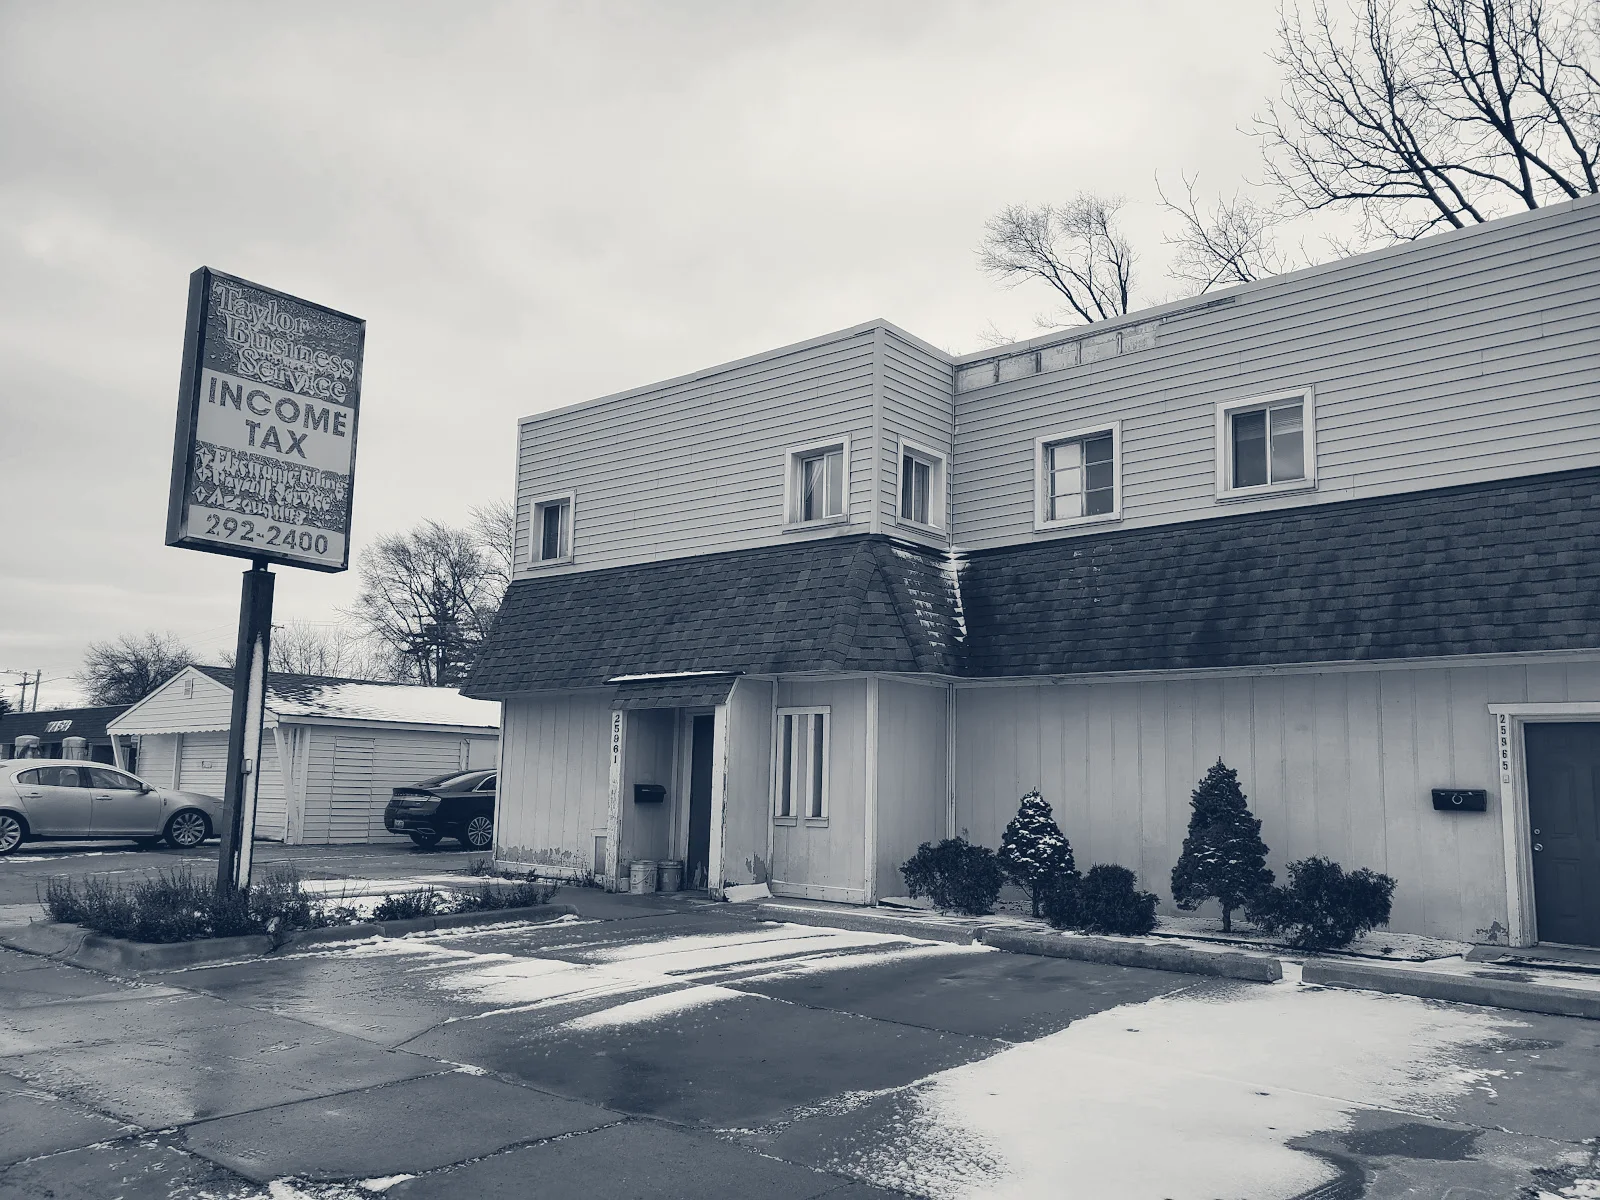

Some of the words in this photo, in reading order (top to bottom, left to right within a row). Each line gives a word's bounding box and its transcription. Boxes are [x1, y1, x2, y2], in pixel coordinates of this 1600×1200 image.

[213, 282, 311, 337] Taylor
[224, 312, 355, 381] Business
[238, 348, 348, 401] Service
[209, 377, 347, 437] INCOME
[246, 419, 308, 459] TAX
[205, 514, 328, 554] 292-2400
[1500, 714, 1508, 770] 25965
